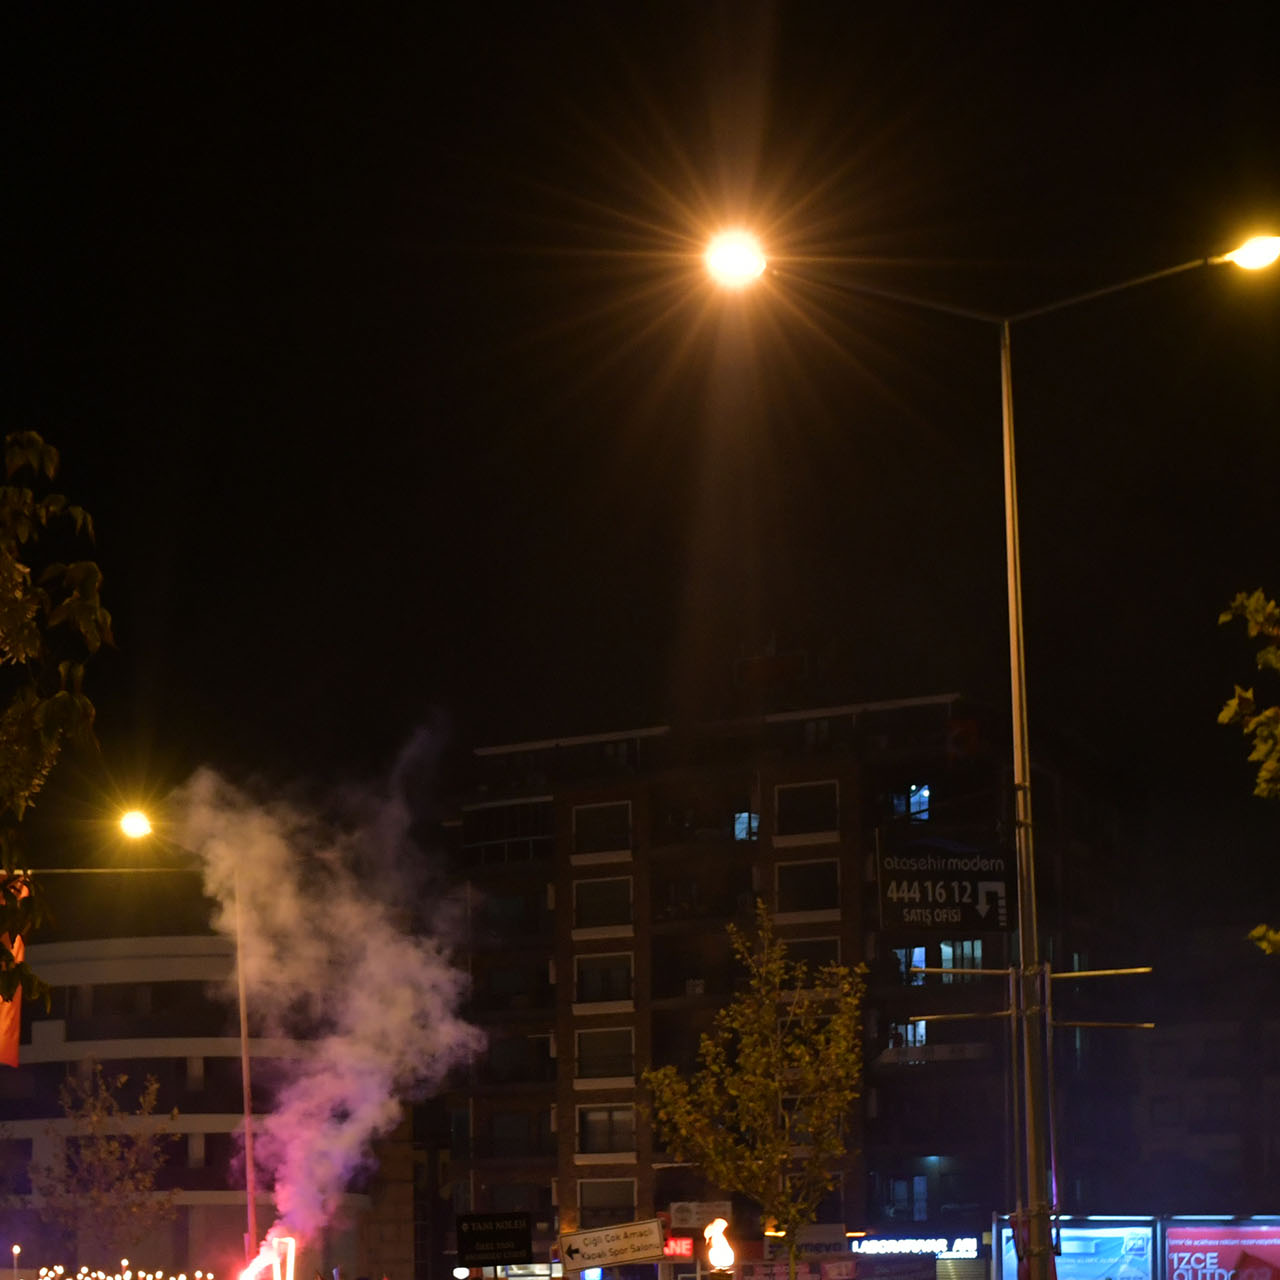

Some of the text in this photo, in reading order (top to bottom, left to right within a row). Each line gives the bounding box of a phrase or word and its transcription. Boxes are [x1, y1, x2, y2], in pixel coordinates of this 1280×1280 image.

[886, 880, 973, 904] 444 16 12
[608, 1246, 628, 1258] Spor
